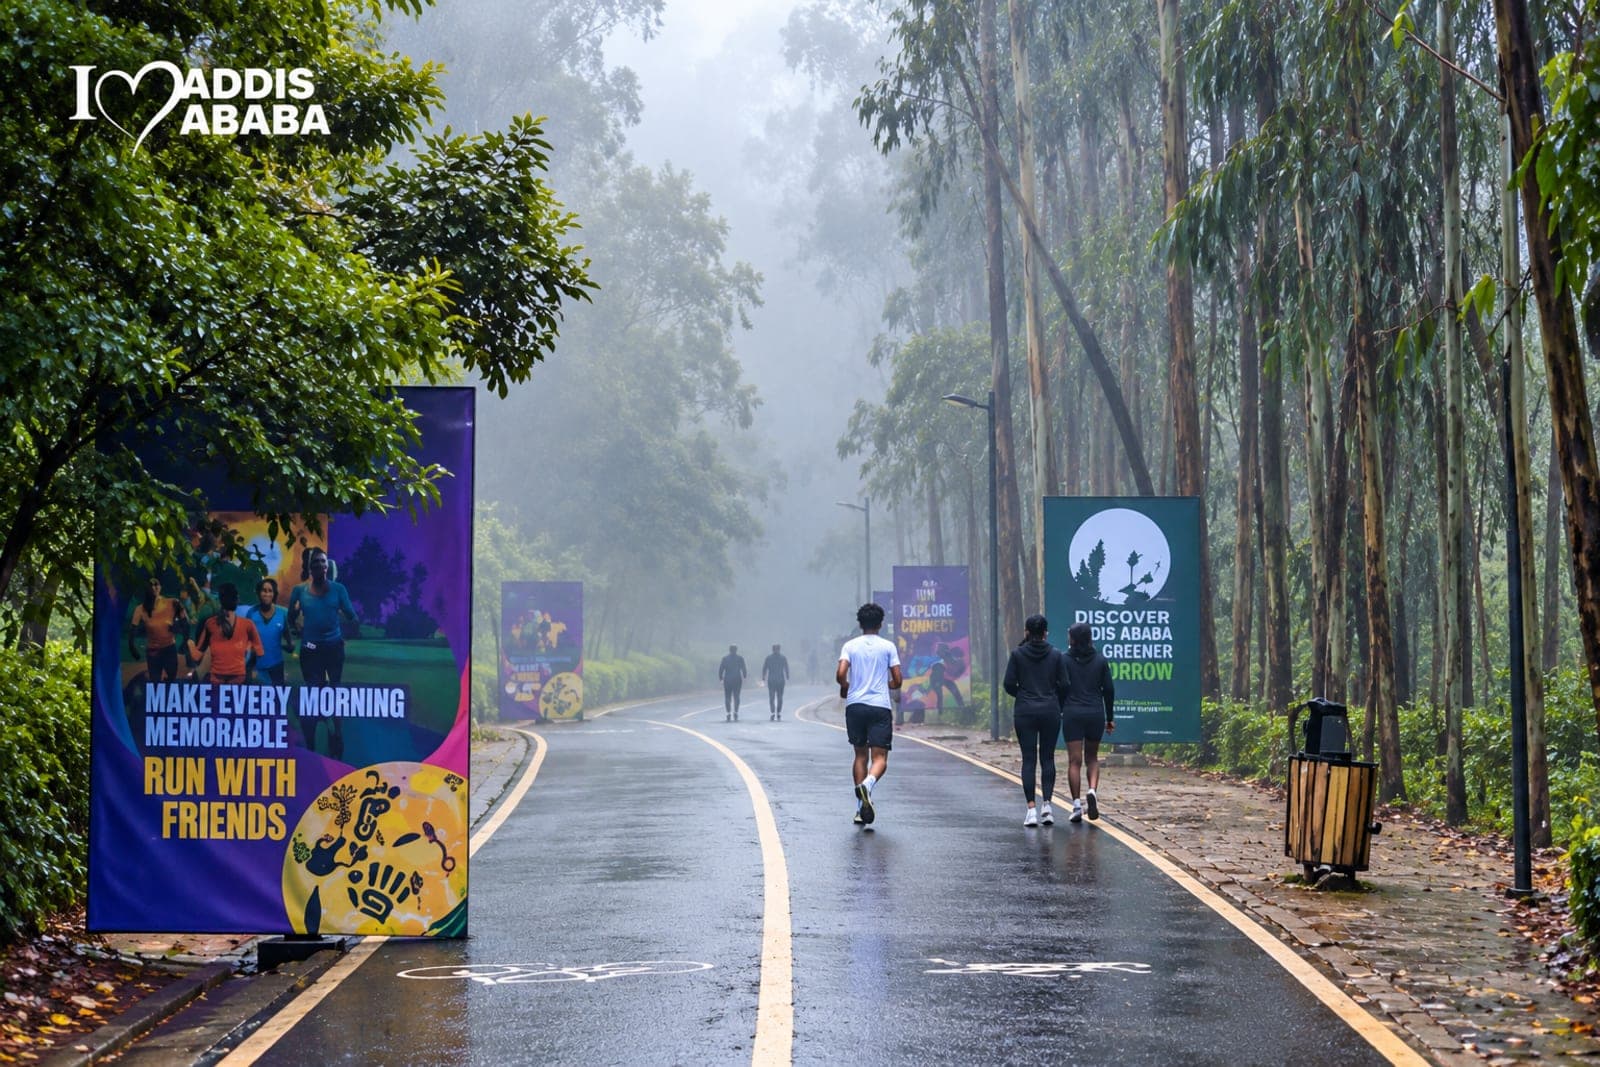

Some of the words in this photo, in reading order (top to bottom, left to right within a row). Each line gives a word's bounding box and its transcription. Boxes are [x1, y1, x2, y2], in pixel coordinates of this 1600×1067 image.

[902, 603, 953, 617] EXPLORE
[1075, 610, 1170, 624] DISCOVER
[1091, 626, 1117, 641] DIS
[1120, 626, 1173, 641] ABABA
[1102, 644, 1173, 659] GREENER
[1109, 662, 1173, 681] ORROW
[145, 682, 213, 713] MAKE
[218, 684, 292, 716] EVERY
[299, 686, 405, 718] MORNING
[145, 716, 289, 749] MEMORABLE
[144, 756, 206, 796] RUN
[215, 758, 297, 797] WITH
[162, 801, 288, 841] FRIENDS
